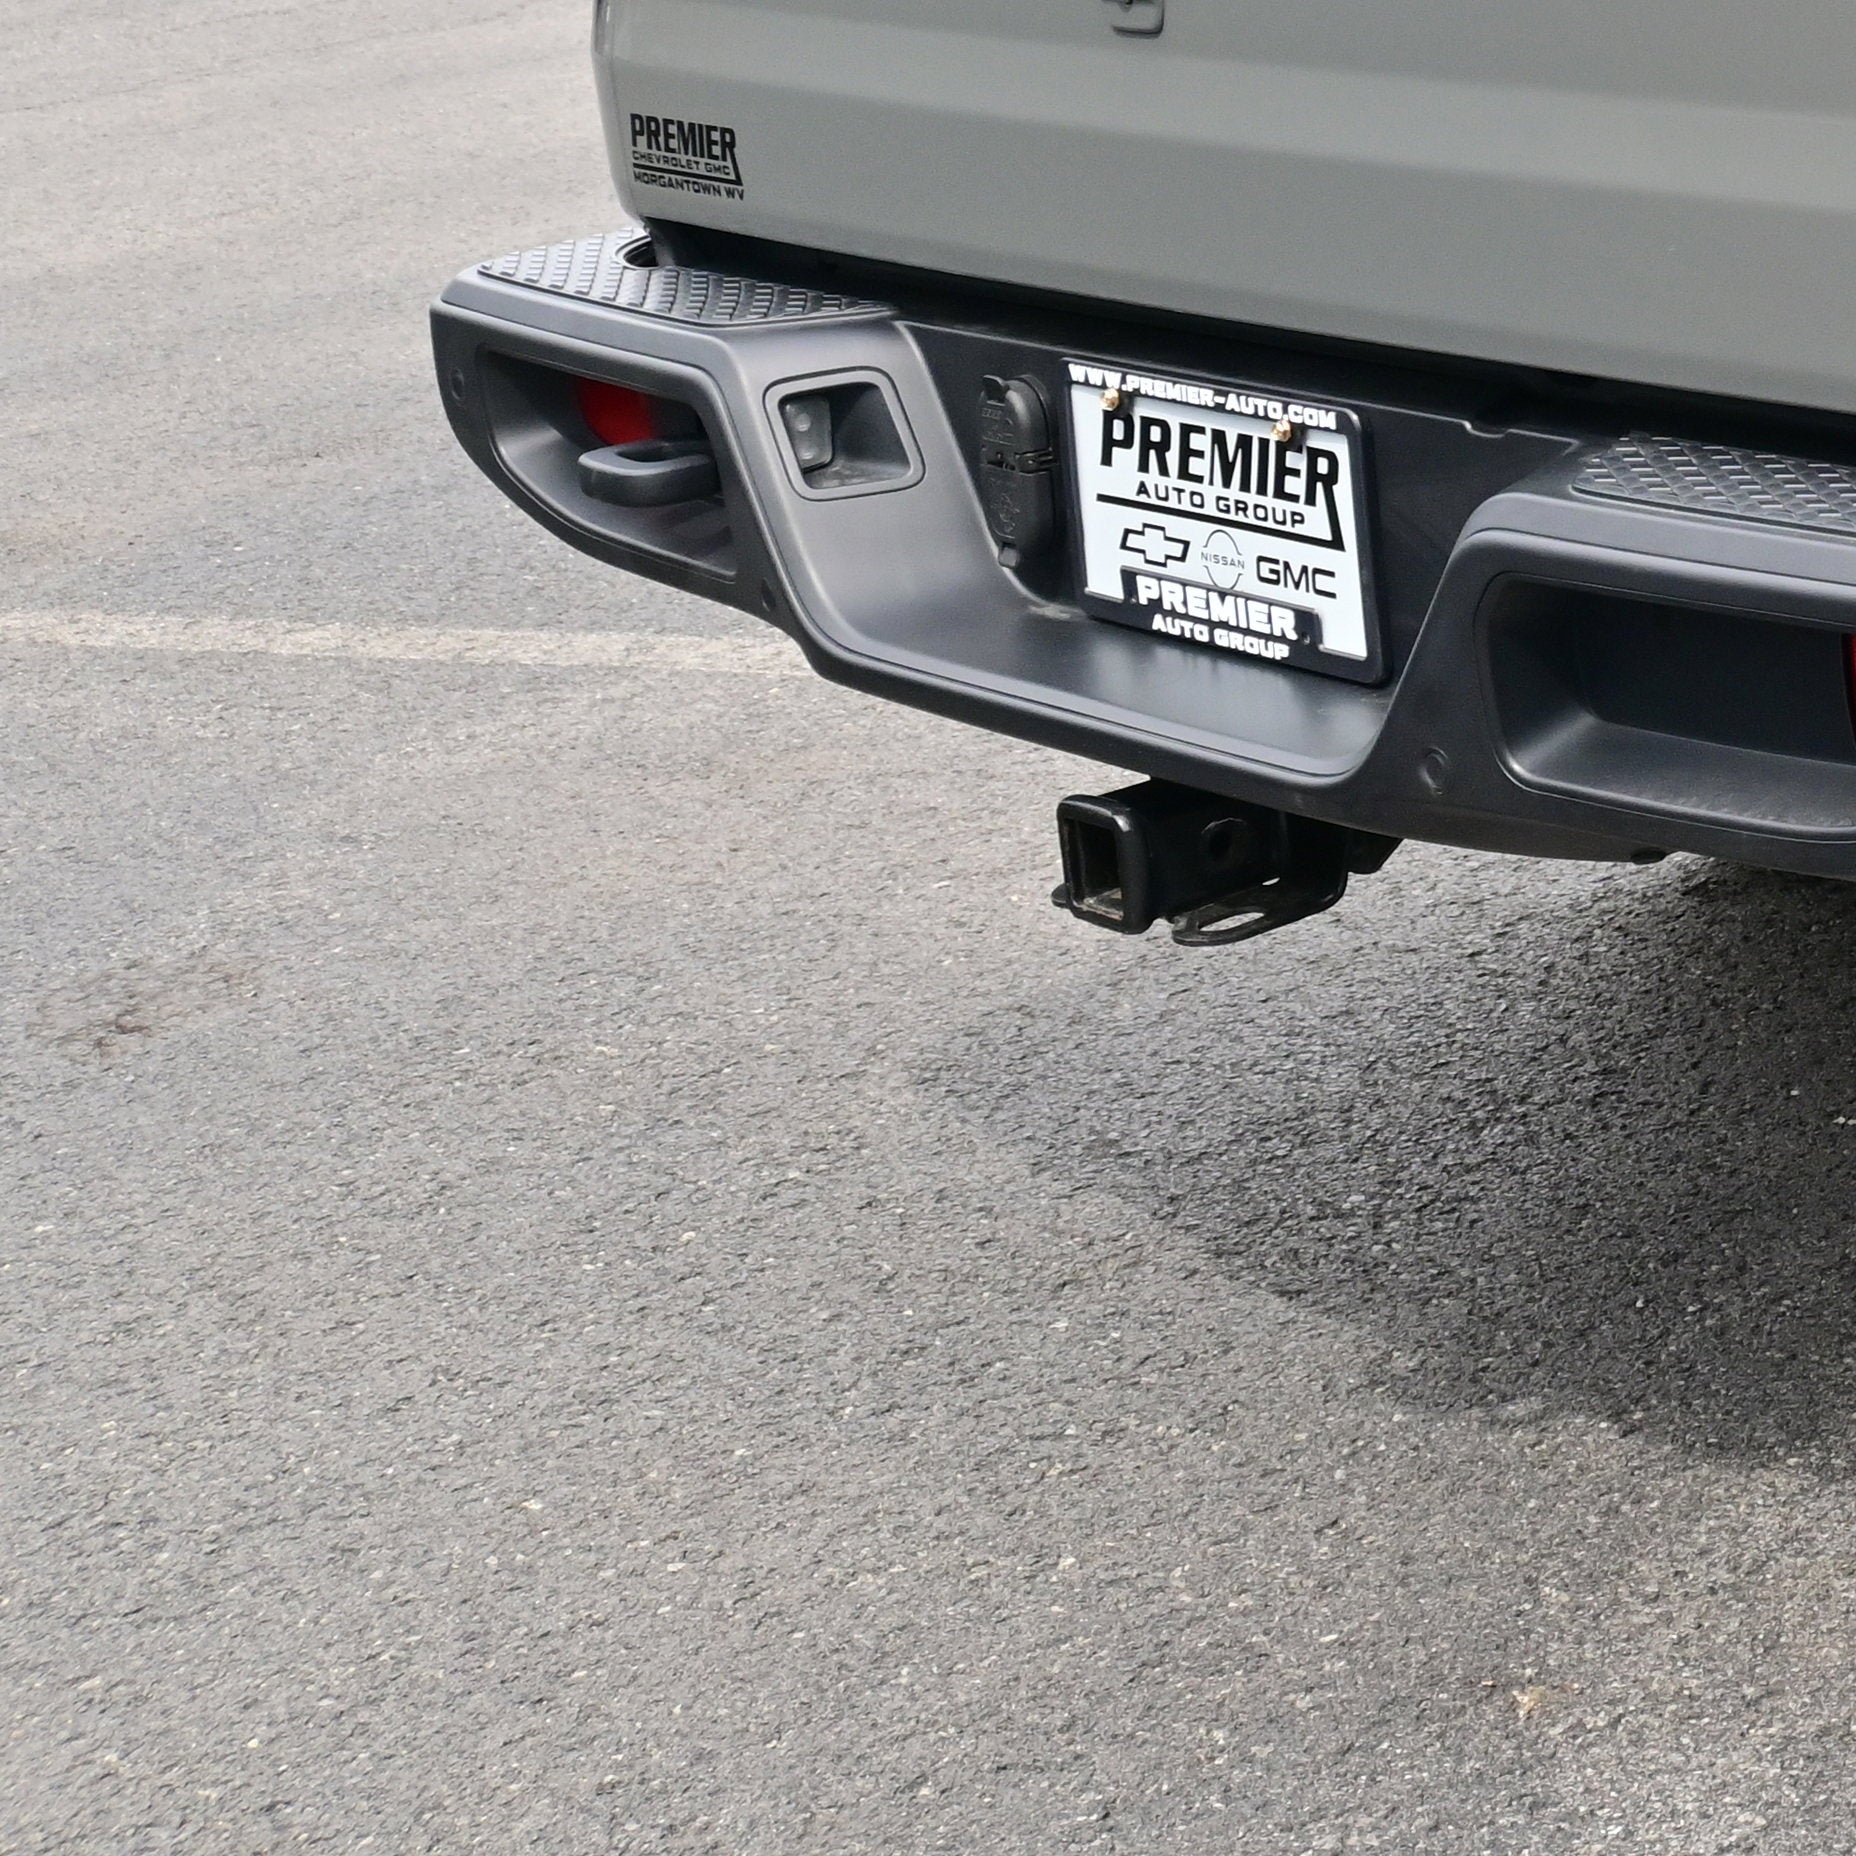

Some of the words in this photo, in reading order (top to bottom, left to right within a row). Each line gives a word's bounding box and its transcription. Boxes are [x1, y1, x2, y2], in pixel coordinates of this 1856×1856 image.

[630, 113, 738, 163] PREMIER
[632, 150, 700, 171] CHEVROLET
[704, 161, 731, 176] GMC
[633, 170, 722, 196] MORGANTOWN
[724, 188, 745, 201] WV
[1068, 363, 1337, 430] WWW.PREMIER-AUTO.COM
[1100, 410, 1340, 508] PREMIER
[1135, 480, 1206, 510] AUTO
[1214, 495, 1306, 528] GROUP
[1200, 550, 1246, 570] NISSAN
[1256, 554, 1337, 599] GMC
[1135, 575, 1299, 641] PREMIER
[1151, 613, 1210, 642] AUTO
[1214, 630, 1290, 660] GROUP
